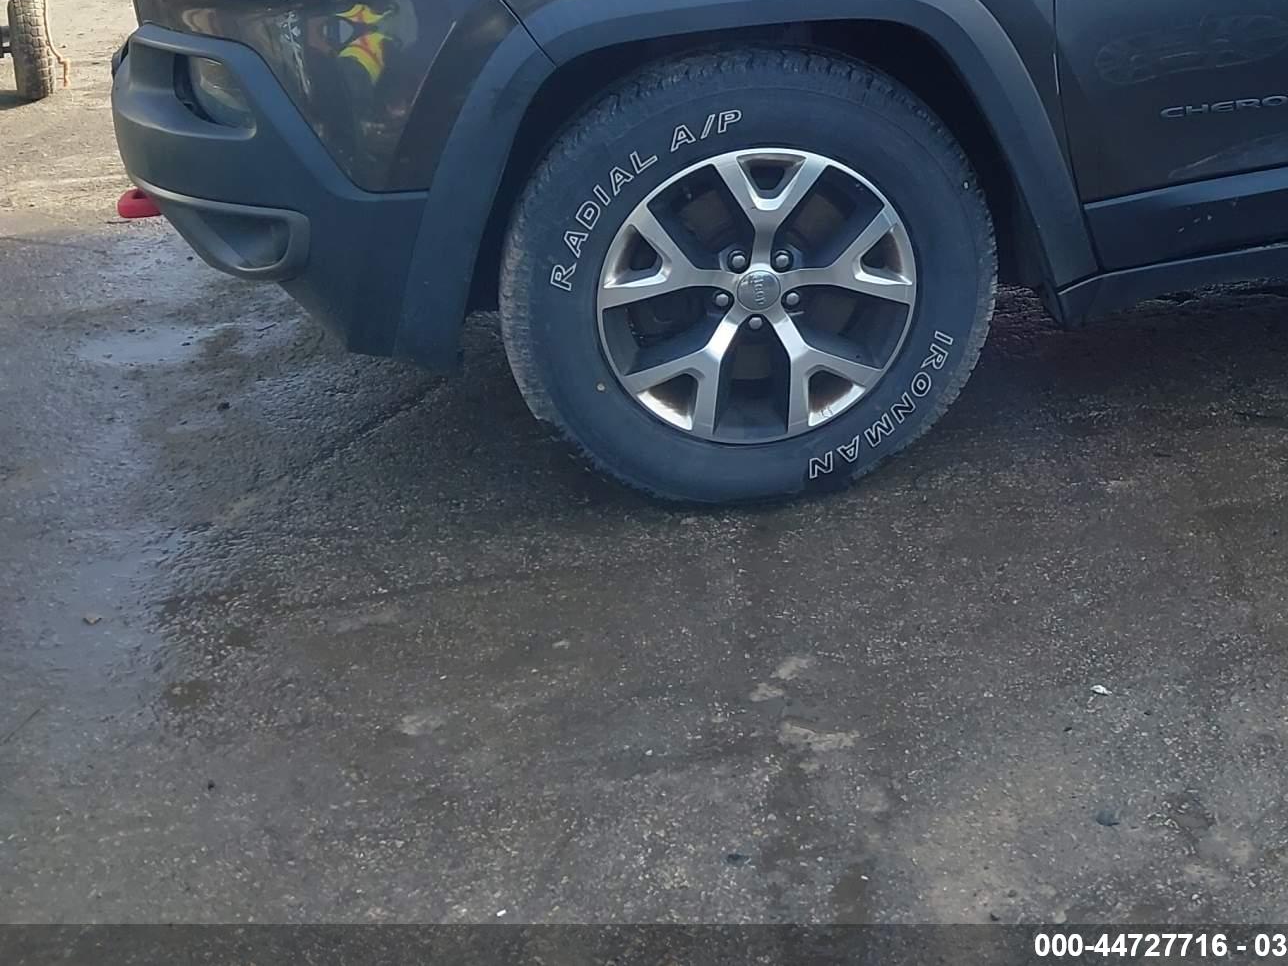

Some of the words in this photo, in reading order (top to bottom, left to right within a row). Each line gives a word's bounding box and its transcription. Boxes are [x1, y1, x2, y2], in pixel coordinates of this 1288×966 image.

[550, 151, 658, 292] RADIAL
[670, 109, 742, 152] A/P
[808, 330, 954, 480] IRONMAN
